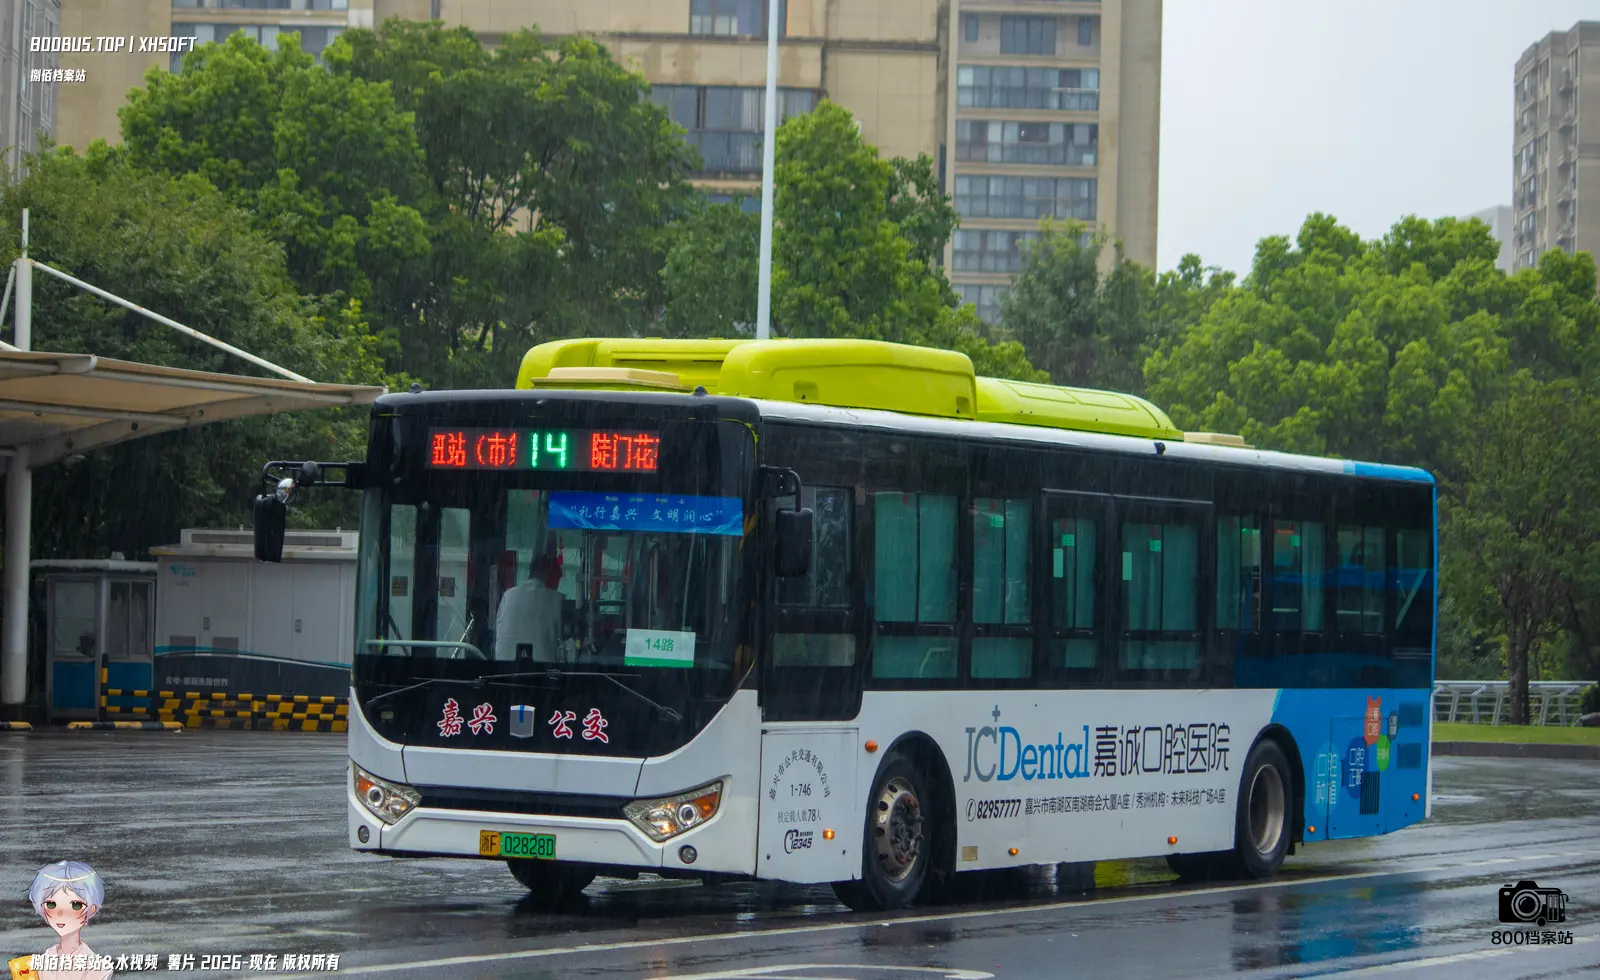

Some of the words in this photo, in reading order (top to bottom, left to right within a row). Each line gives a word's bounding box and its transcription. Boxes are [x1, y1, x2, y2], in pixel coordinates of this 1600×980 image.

[531, 432, 567, 468] 14
[591, 433, 659, 469] 陡门花
[645, 637, 674, 652] 14路
[437, 698, 497, 737] 嘉兴
[548, 708, 609, 744] 公交
[1094, 722, 1230, 778] 嘉诚口腔医院
[768, 747, 831, 801] 嘉兴市公共交通有限公司
[790, 783, 812, 797] 1-746
[777, 808, 822, 824] 核定载人数78人
[976, 798, 1021, 819] 82957777
[504, 835, 554, 856] 02828D
[790, 837, 813, 850] 12345
